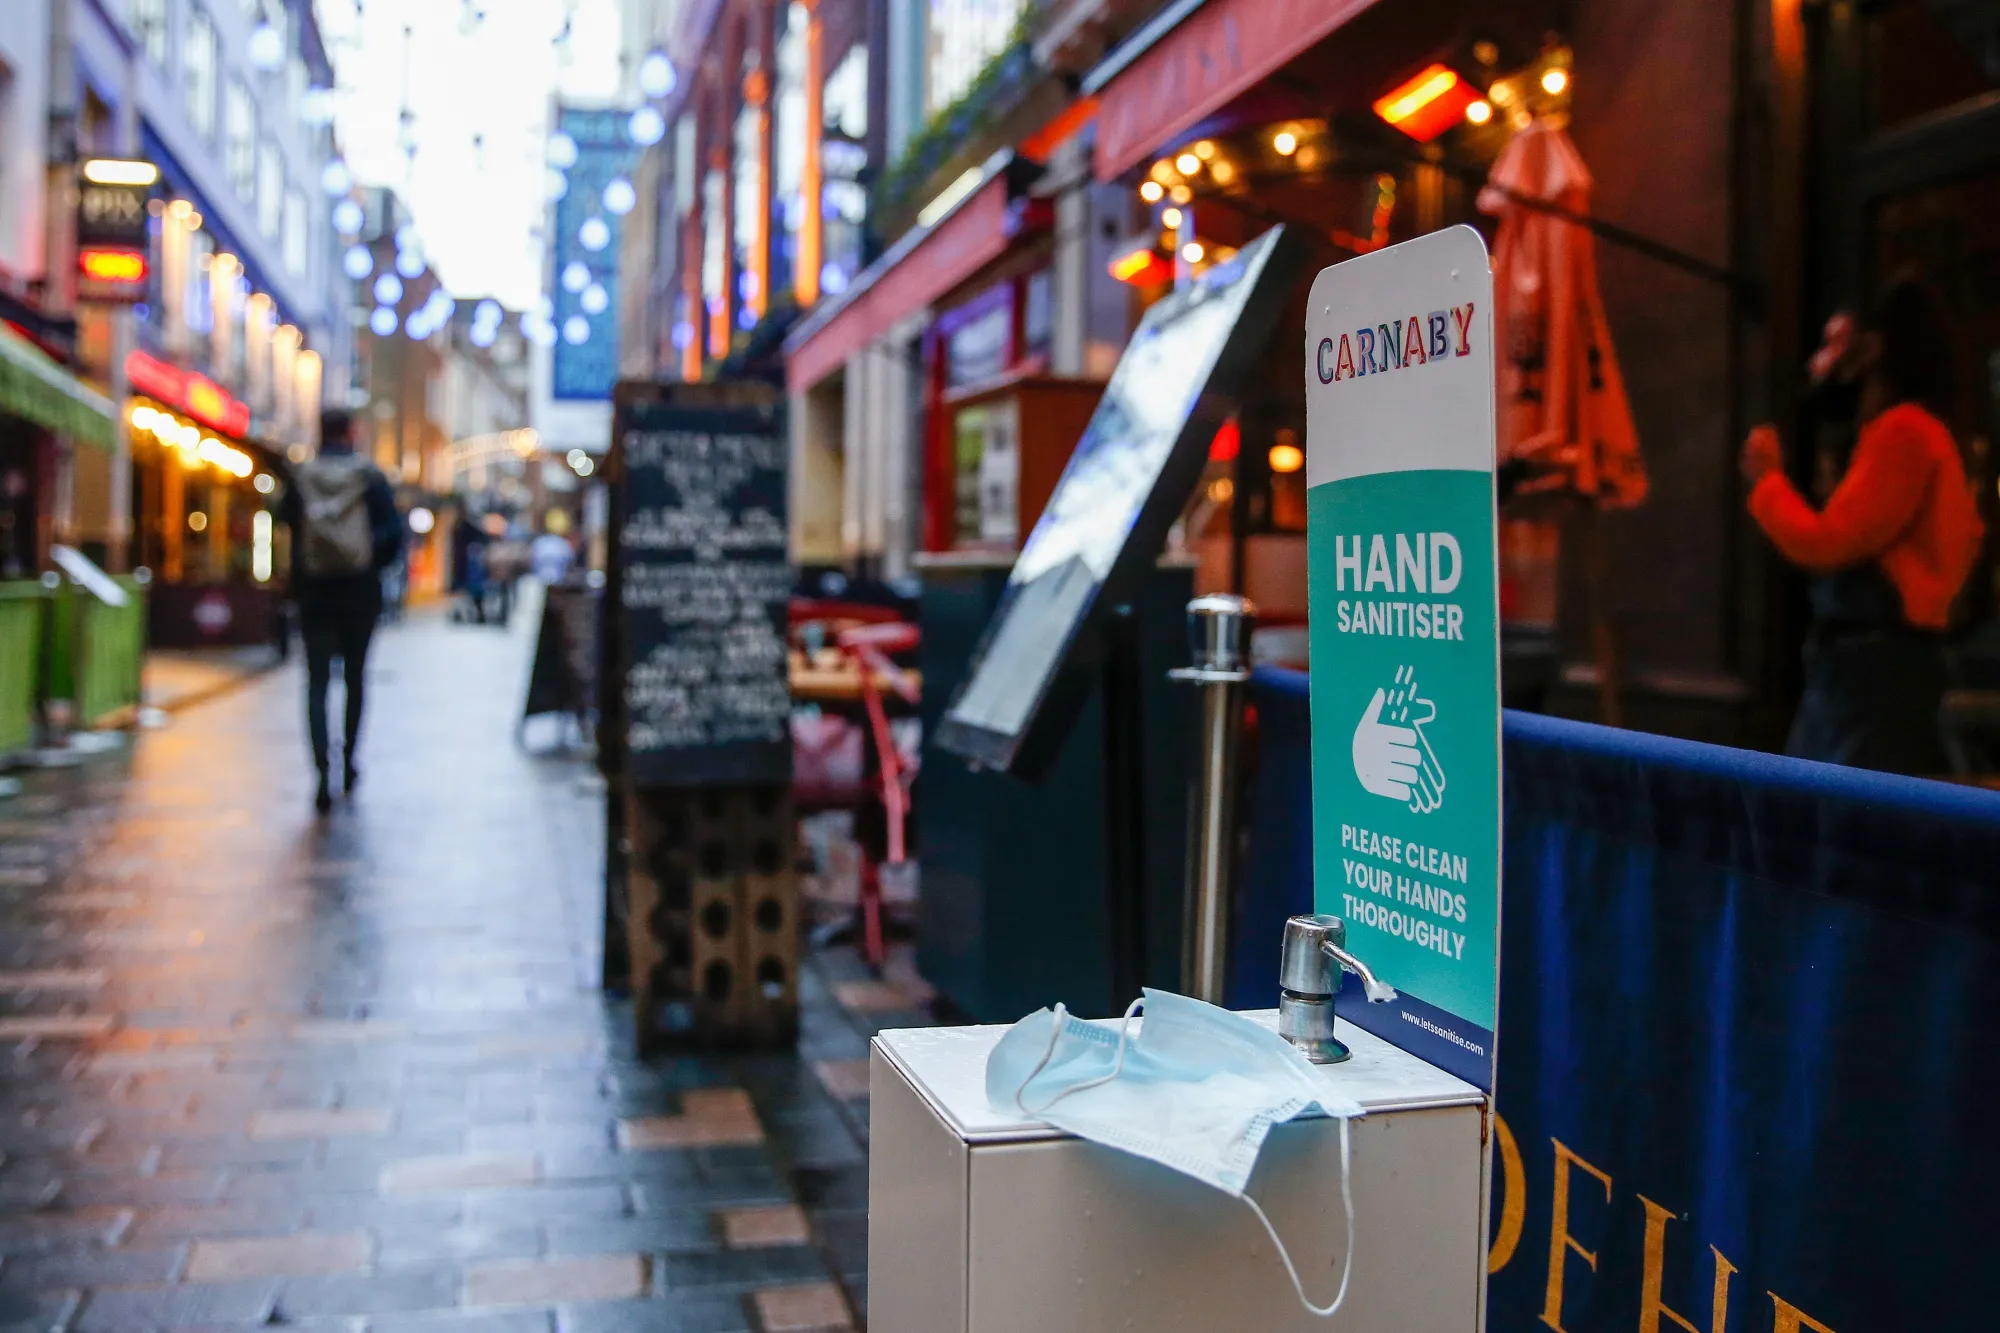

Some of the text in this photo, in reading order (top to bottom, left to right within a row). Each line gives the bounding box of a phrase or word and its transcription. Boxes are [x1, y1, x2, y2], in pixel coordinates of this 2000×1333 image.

[1317, 302, 1474, 384] CARNABY
[1336, 532, 1462, 594] HAND
[1337, 600, 1464, 641] SANITISER
[1341, 823, 1467, 884] PLEASE CLEAN
[1342, 858, 1466, 923] YOUR HANDS
[1342, 893, 1466, 961] THOROUGHLY
[1401, 1010, 1484, 1056] www.letssanitise.com
